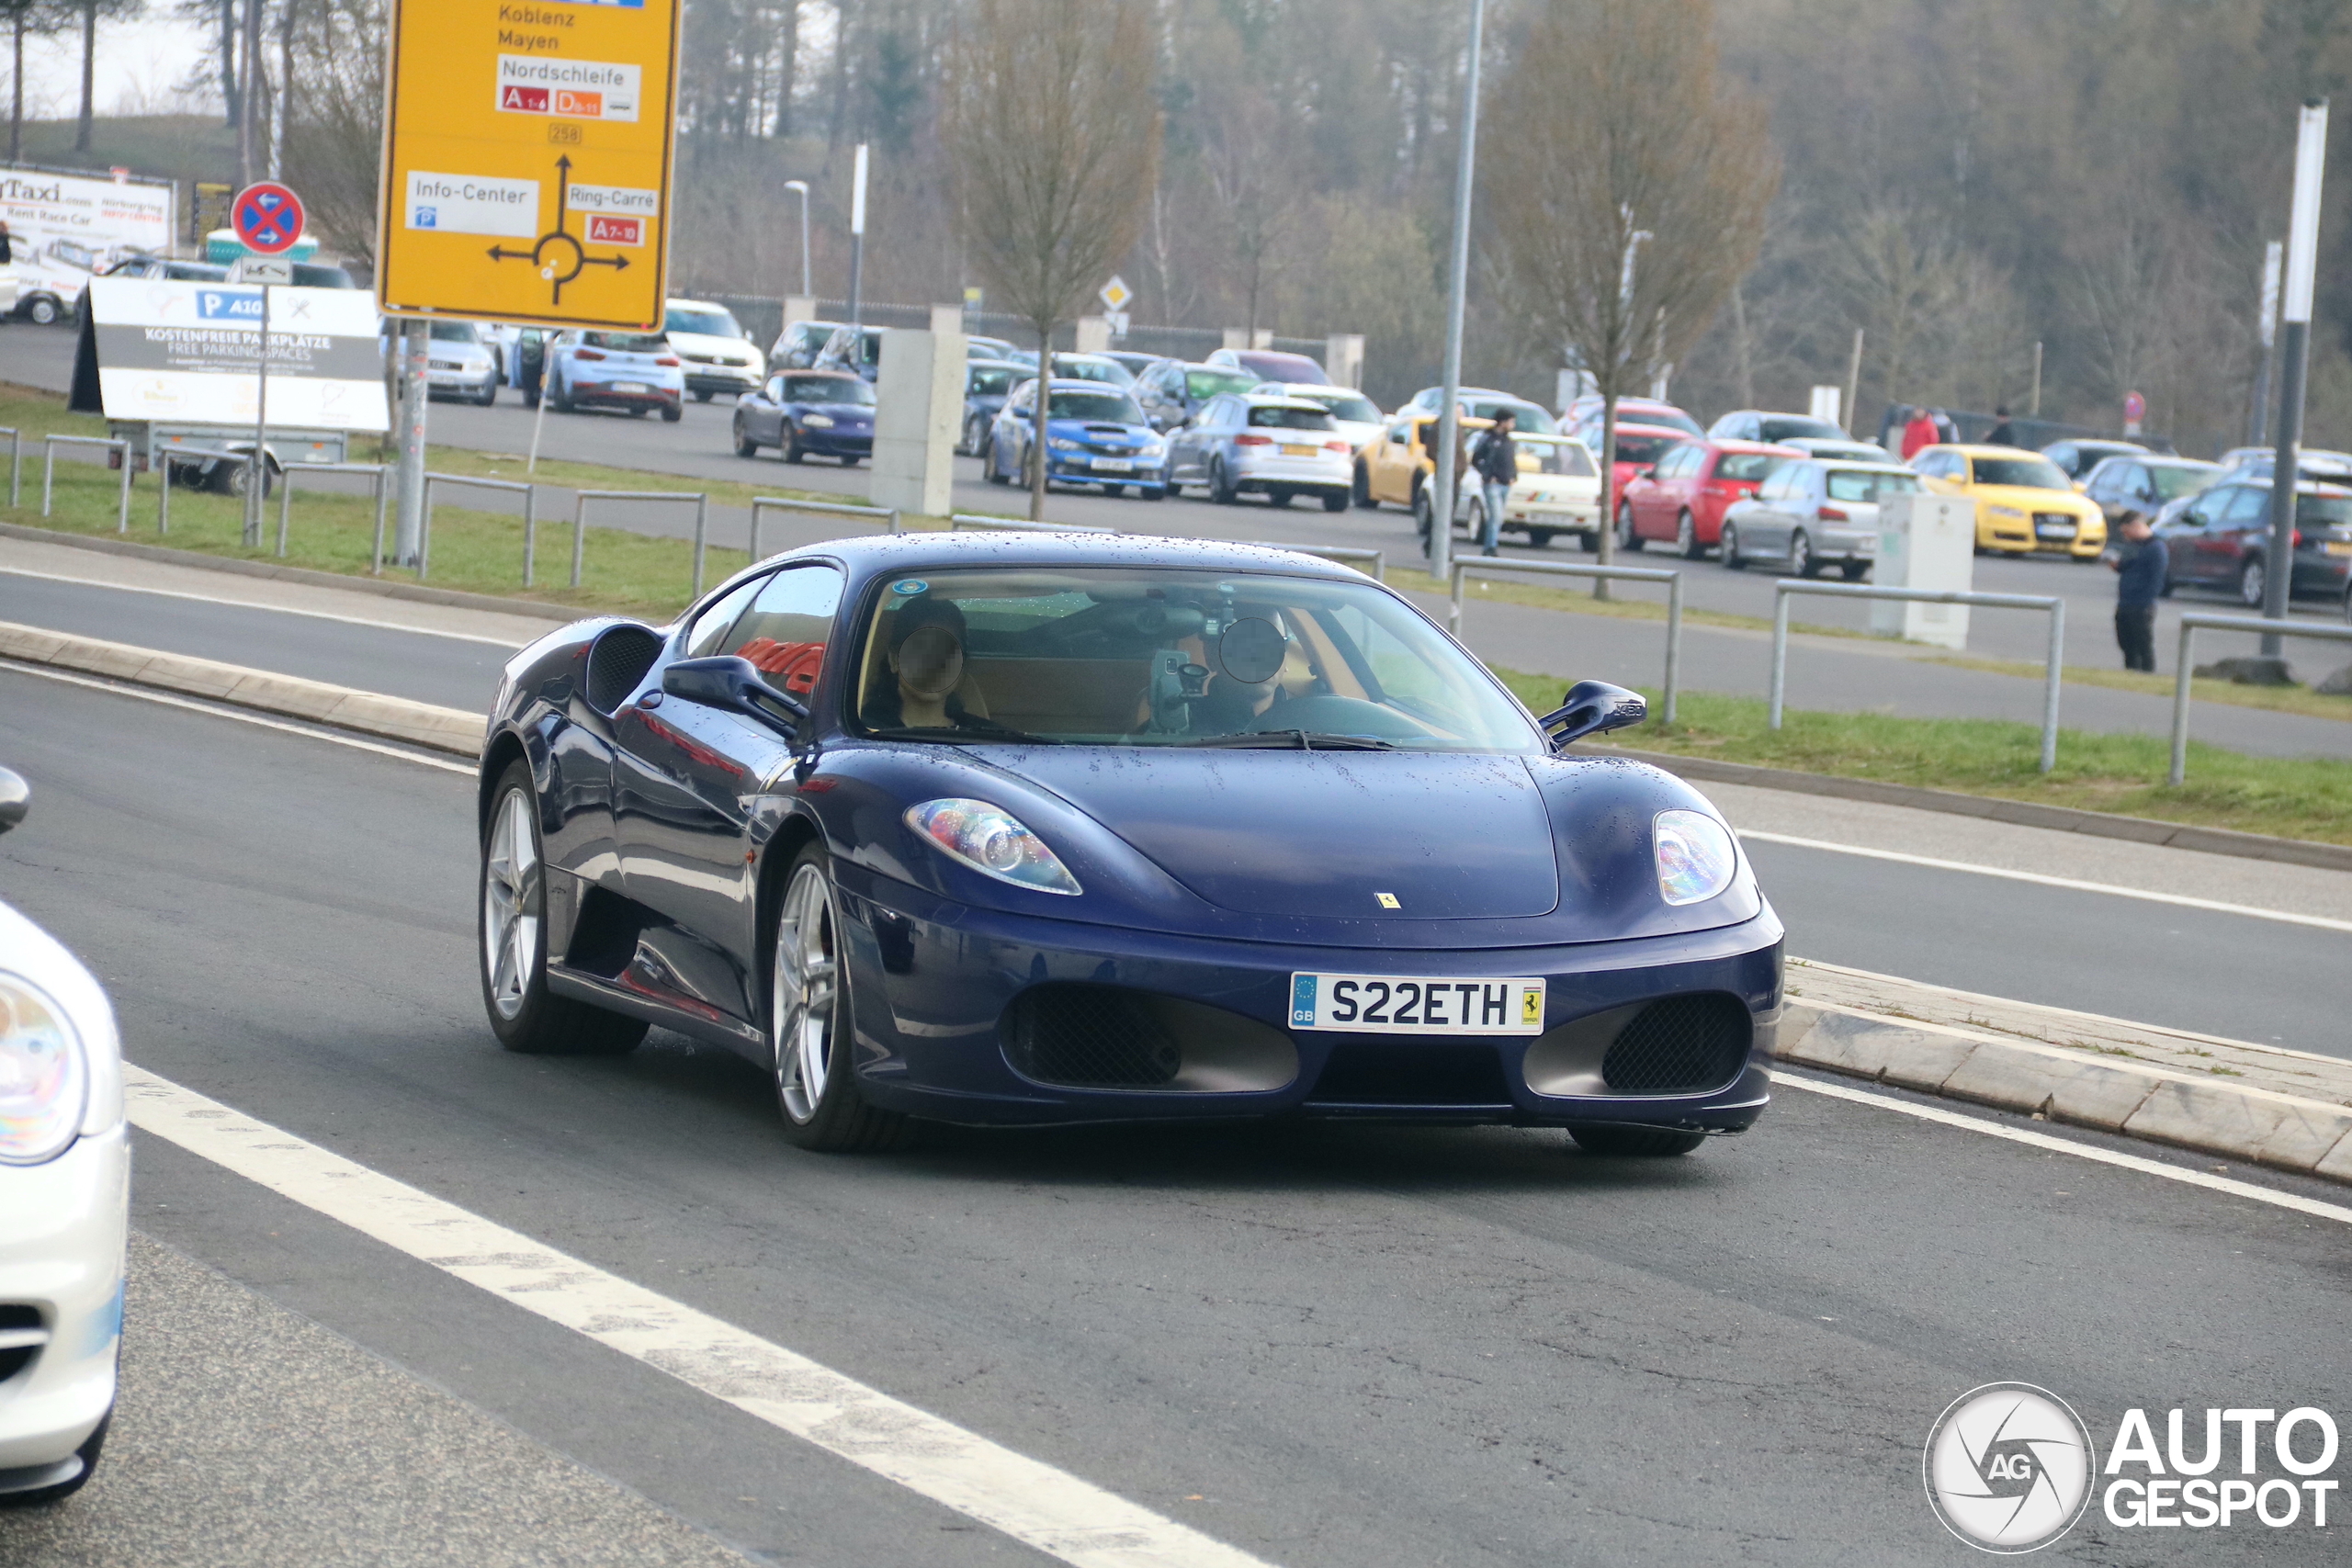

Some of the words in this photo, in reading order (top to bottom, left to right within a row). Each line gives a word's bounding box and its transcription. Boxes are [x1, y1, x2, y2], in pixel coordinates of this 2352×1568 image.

[499, 6, 574, 28] Koblenz
[497, 29, 559, 51] Mayen
[503, 61, 624, 85] Nordschleife
[551, 126, 579, 142] 258
[416, 180, 526, 205] Info-Center
[570, 187, 653, 208] Ring-Carré
[7, 207, 34, 219] Rent
[40, 209, 67, 222] Race
[71, 214, 90, 226] Car
[204, 294, 222, 316] P
[145, 328, 240, 344] KOSTENFREIE
[168, 342, 199, 355] FREE
[202, 344, 261, 359] PARKING
[1332, 980, 1508, 1025] S22ETH
[1294, 1010, 1314, 1021] GB
